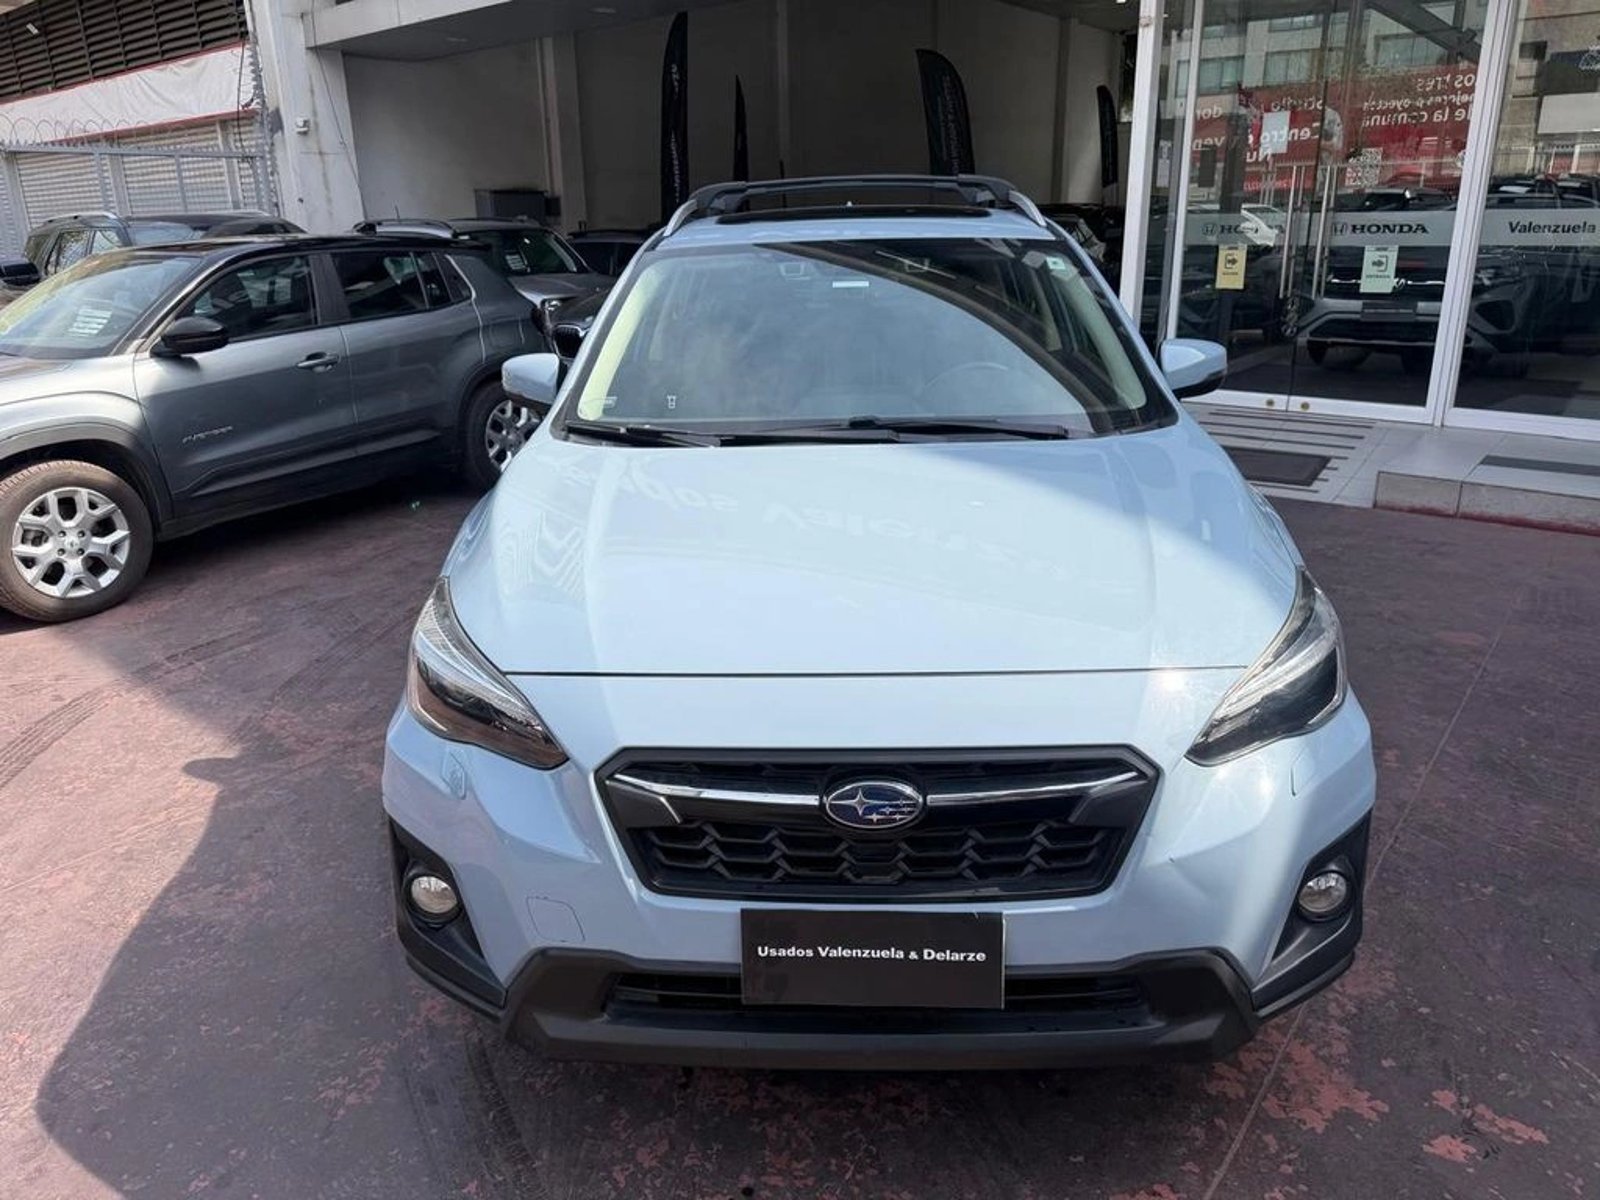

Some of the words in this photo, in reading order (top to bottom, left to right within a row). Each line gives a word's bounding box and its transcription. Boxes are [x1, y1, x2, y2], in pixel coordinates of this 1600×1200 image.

[1350, 223, 1429, 235] HONDA
[1508, 220, 1597, 234] Valenzuela
[757, 945, 814, 958] Usados
[817, 945, 905, 960] Valenzuela
[908, 950, 920, 961] &
[922, 948, 987, 963] Delarze
